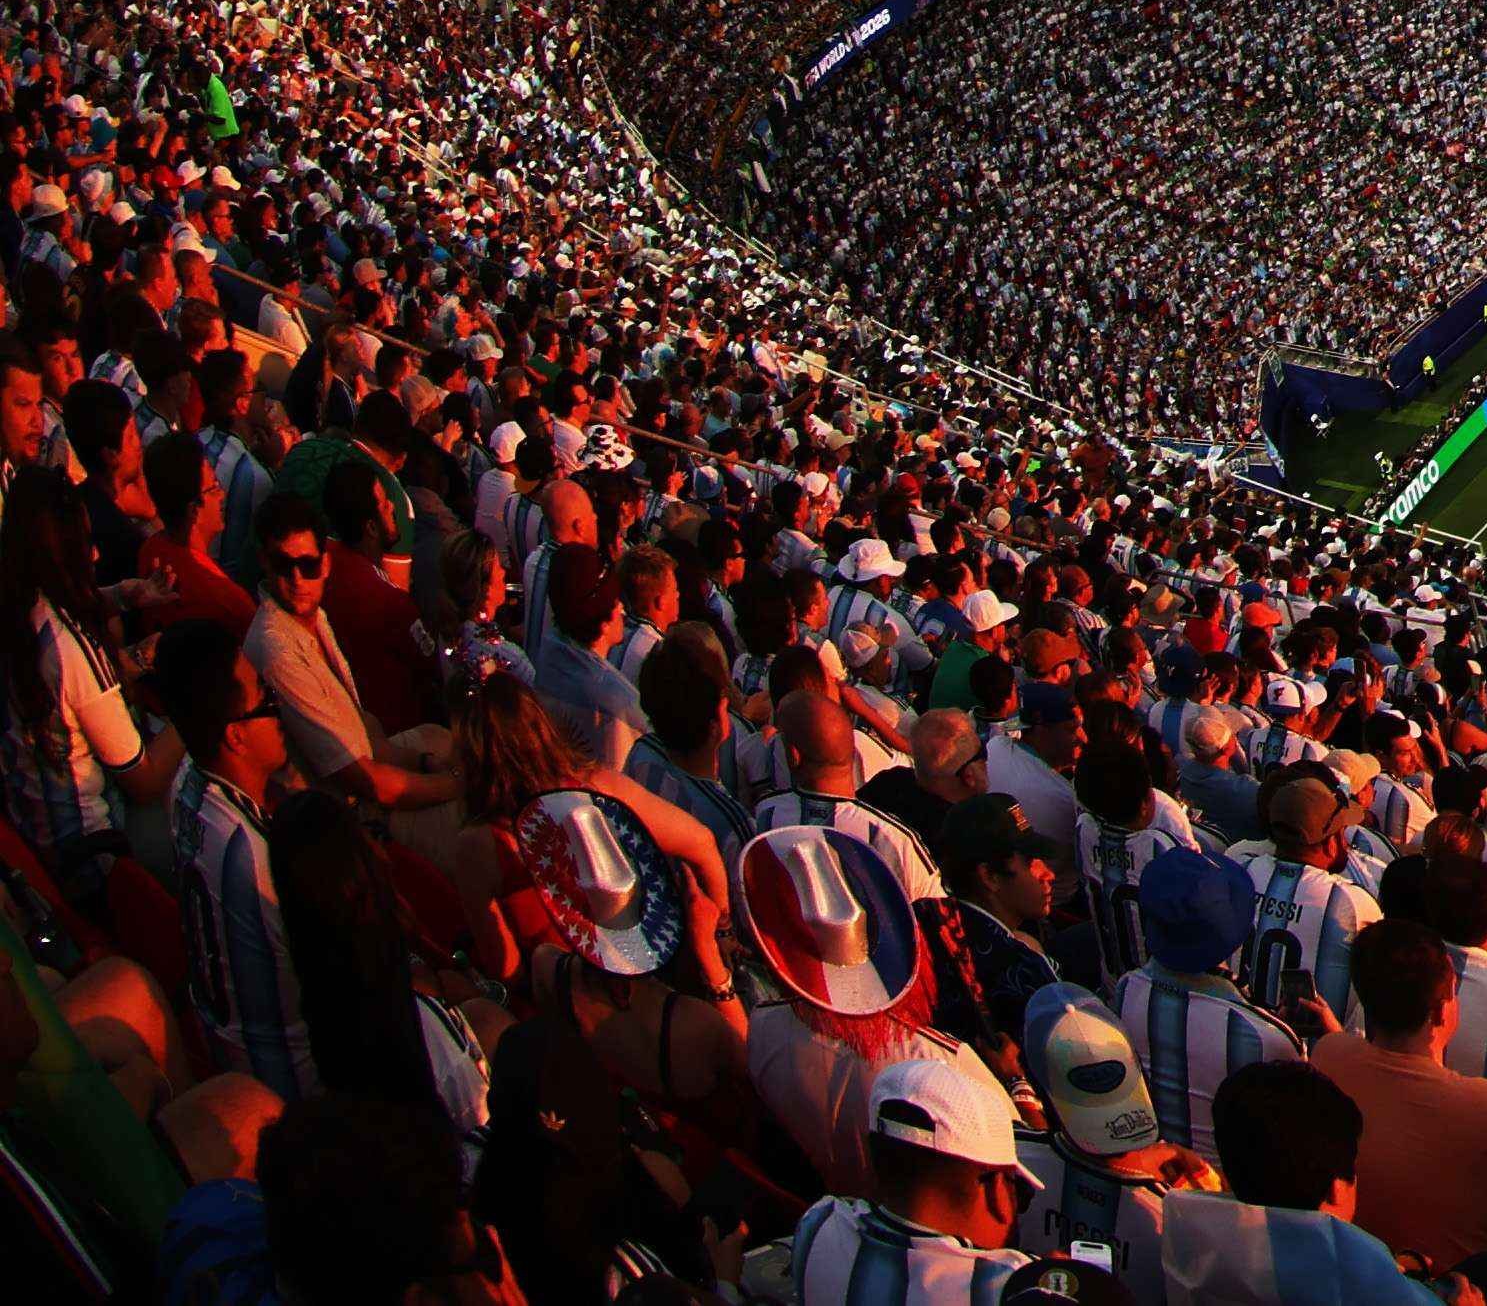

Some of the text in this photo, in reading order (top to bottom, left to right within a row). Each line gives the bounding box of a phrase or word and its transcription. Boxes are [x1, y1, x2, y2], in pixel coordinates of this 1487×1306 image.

[860, 8, 892, 42] 2026
[1379, 459, 1440, 534] ramco
[1093, 845, 1136, 871] MESSI
